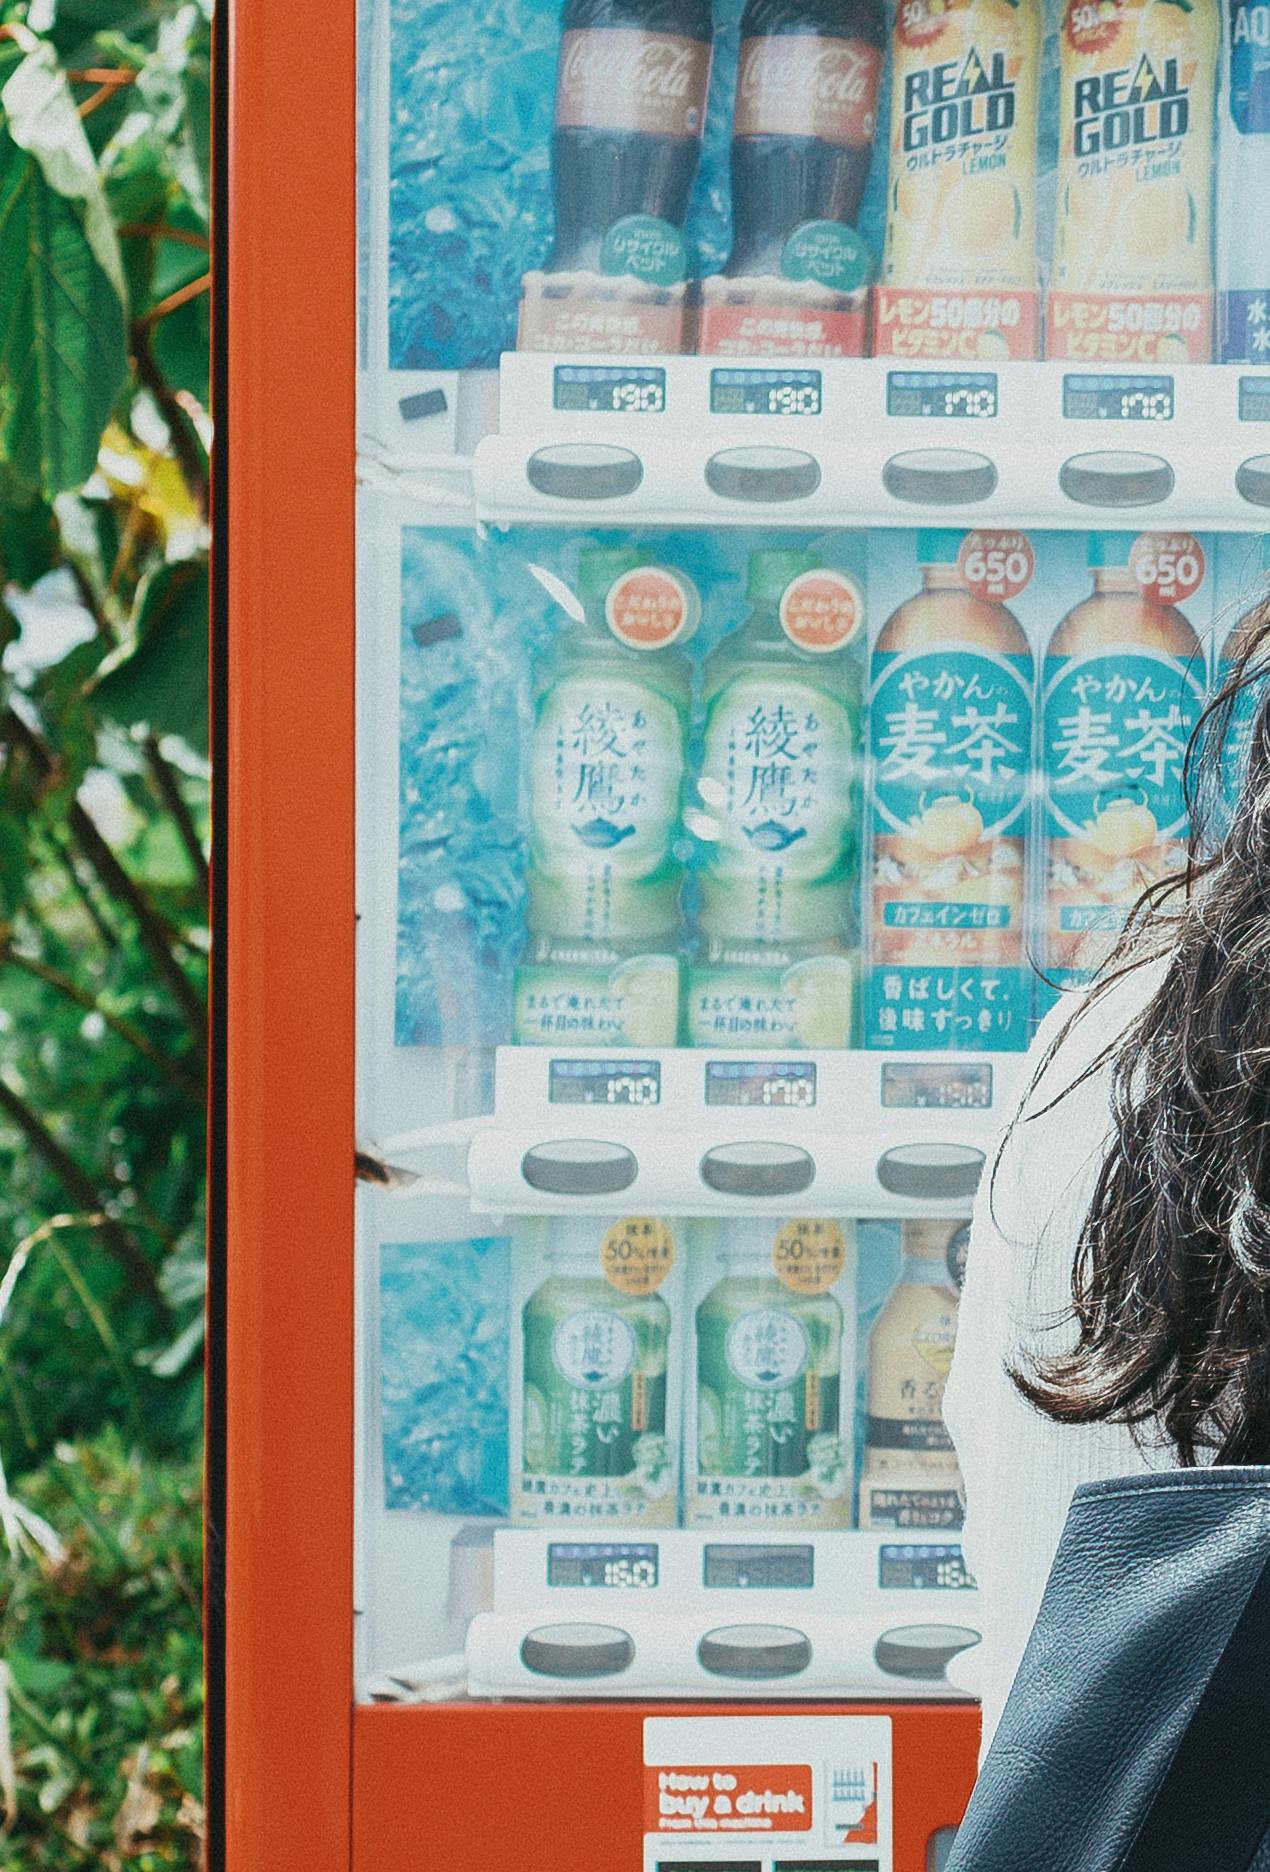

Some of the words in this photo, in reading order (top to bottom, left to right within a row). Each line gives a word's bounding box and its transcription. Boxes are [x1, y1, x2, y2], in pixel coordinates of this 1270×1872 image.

[904, 47, 1016, 113] REAL
[1073, 53, 1189, 119] REAL
[903, 91, 1015, 152] GOLD
[1073, 97, 1188, 158] GOLD
[906, 135, 1011, 172] ウルトラチャージ
[961, 154, 1006, 176] LEMON
[1078, 141, 1184, 177] ウルトラチャージ
[1135, 162, 1181, 184] LEMON
[612, 383, 662, 412] 190
[768, 386, 819, 415] 190
[962, 553, 1028, 584] 650
[1133, 554, 1199, 586] 650
[879, 703, 1022, 787] 麦茶
[1051, 706, 1191, 789] 麦茶
[892, 907, 1001, 925] カフェインゼロ
[878, 1009, 1012, 1032] 後味すっきり
[658, 1772, 710, 1791] How
[712, 1772, 738, 1791] to
[658, 1791, 710, 1819] buy
[735, 1789, 805, 1814] drink
